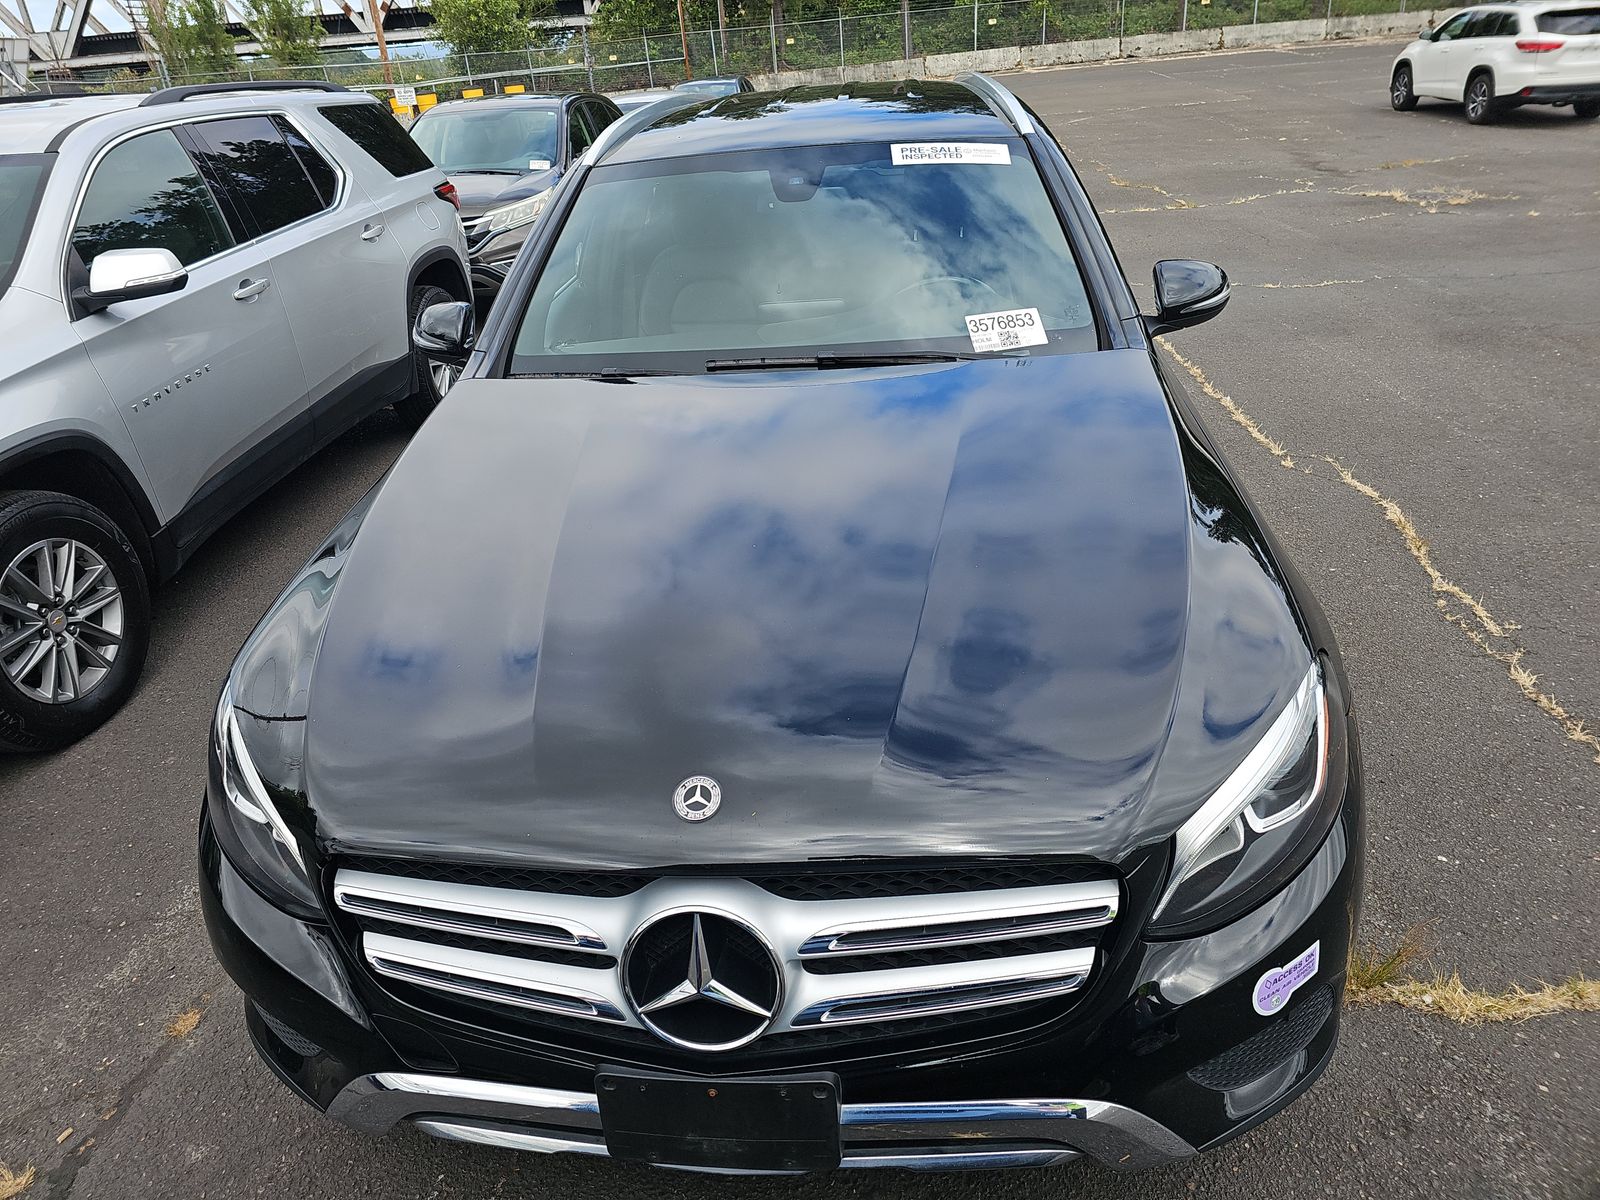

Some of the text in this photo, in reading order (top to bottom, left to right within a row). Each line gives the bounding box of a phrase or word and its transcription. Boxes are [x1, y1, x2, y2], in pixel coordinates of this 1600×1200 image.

[900, 146, 962, 154] PRE-SALE
[969, 312, 1035, 333] 3576853
[131, 363, 212, 413] TRAVERSE
[1272, 960, 1303, 986] ACCESS
[1260, 988, 1280, 1002] CLEAN
